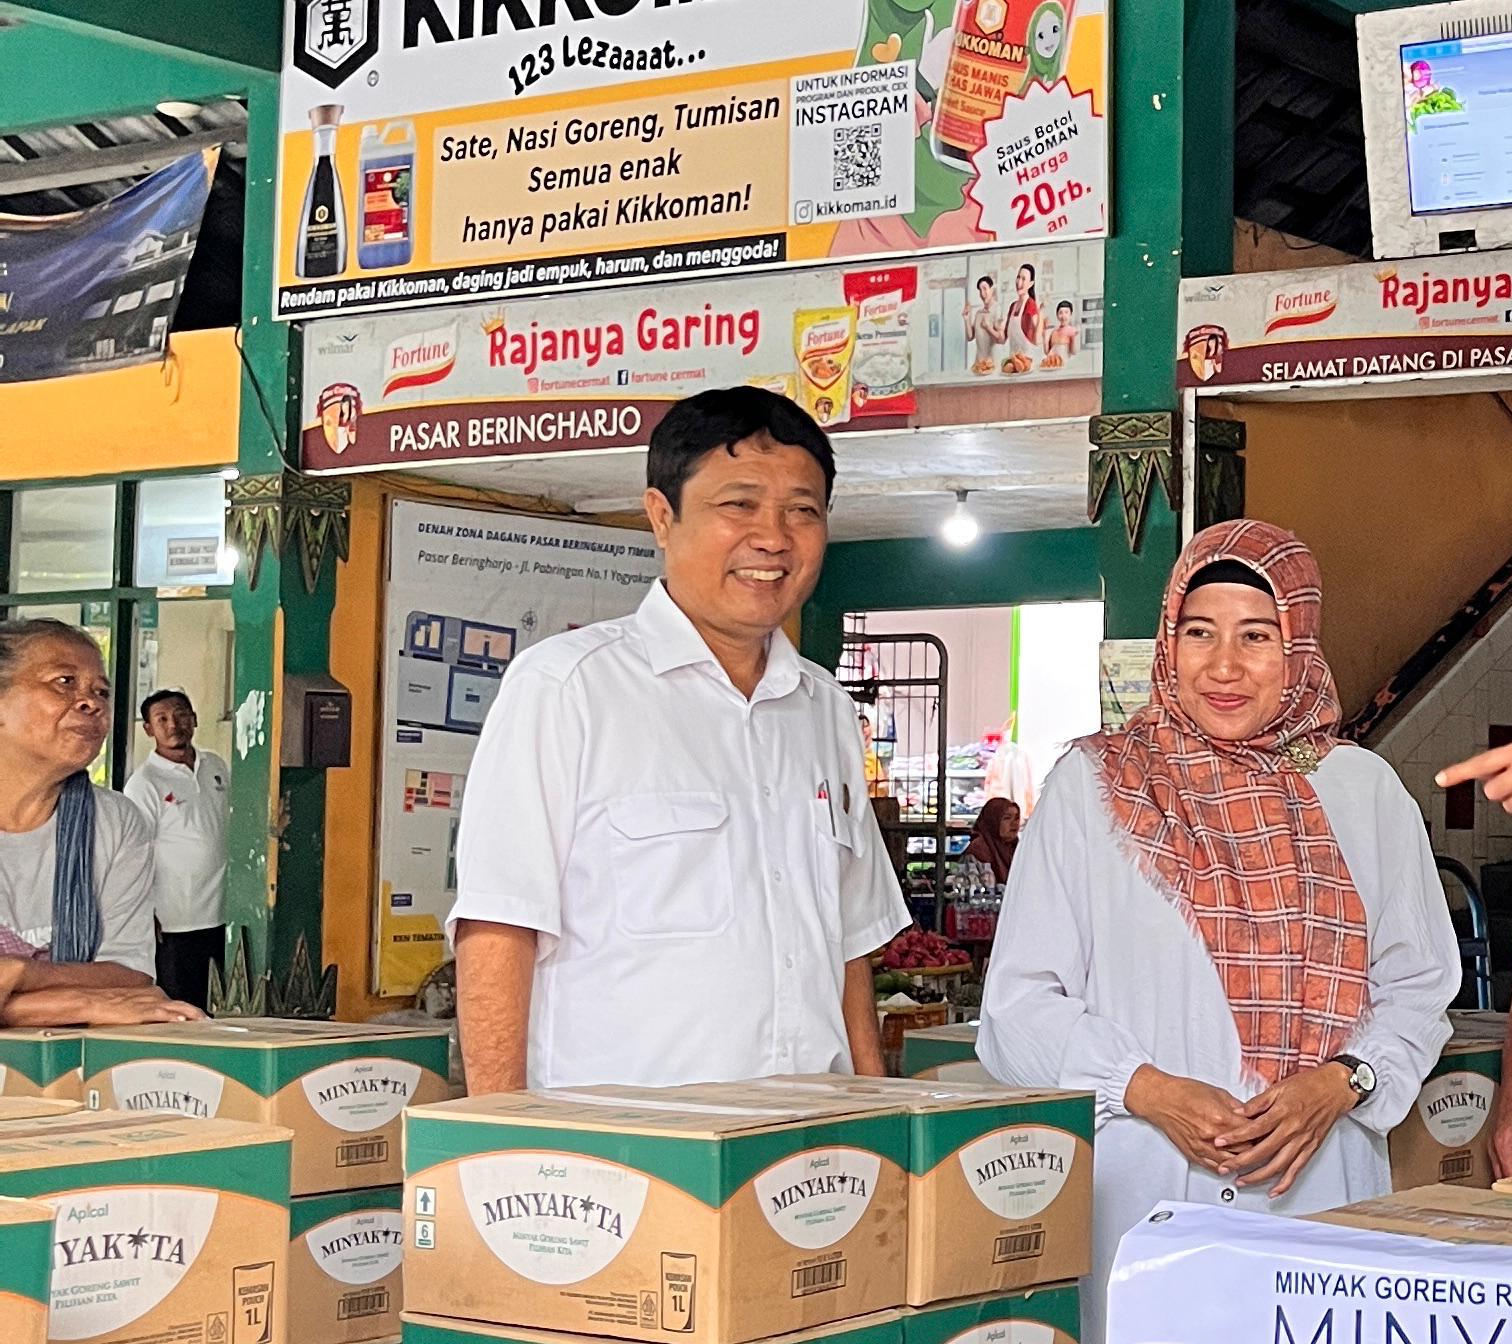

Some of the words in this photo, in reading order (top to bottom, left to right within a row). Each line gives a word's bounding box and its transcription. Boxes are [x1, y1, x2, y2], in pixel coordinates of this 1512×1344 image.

[508, 43, 555, 95] 123
[797, 75, 838, 92] UNTUK
[840, 65, 908, 87] INFORMASI
[441, 136, 498, 162] Sate,
[506, 122, 557, 154] Nasi
[565, 114, 664, 145] Goreng,
[674, 96, 780, 131] Tumisan
[796, 94, 908, 126] INSTAGRAM
[996, 135, 1031, 159] Saus
[1035, 110, 1073, 140] Botol
[998, 123, 1079, 176] KIKKOMAN
[528, 164, 611, 192] Semua
[620, 148, 682, 180] enak
[1016, 150, 1069, 186] Harga
[462, 216, 533, 245] hanya
[540, 200, 608, 242] pakai
[616, 184, 752, 225] Kikkoman!
[816, 195, 897, 217] kikkoman.id
[1010, 176, 1092, 230] 20rb.
[1047, 215, 1068, 233] an
[281, 287, 335, 309] Rendam
[336, 278, 376, 306] pakai
[377, 275, 450, 299] Kikkoman,
[452, 270, 503, 295] daging
[503, 263, 534, 289] jadi
[537, 258, 592, 286] empuk,
[595, 254, 650, 276] harum,
[652, 251, 682, 270] dan
[686, 238, 779, 269] menggoda!
[1382, 272, 1512, 314] Rajanya
[1261, 357, 1347, 382] SELAMAT
[1352, 352, 1436, 376] DATANG
[1442, 350, 1463, 369] DI
[390, 421, 460, 452] PASAR
[468, 405, 641, 445] BERINGHARJO
[418, 522, 453, 536] DENAH
[455, 527, 484, 540] ZONA
[486, 530, 528, 546] DAGANG
[530, 535, 561, 548] PASAR
[563, 537, 625, 556] BERINGHARJO
[626, 546, 656, 558] TIMUR
[418, 550, 449, 566] Pasar
[1275, 1271, 1367, 1298] MINYAK
[1375, 1276, 1486, 1306] GORENG
